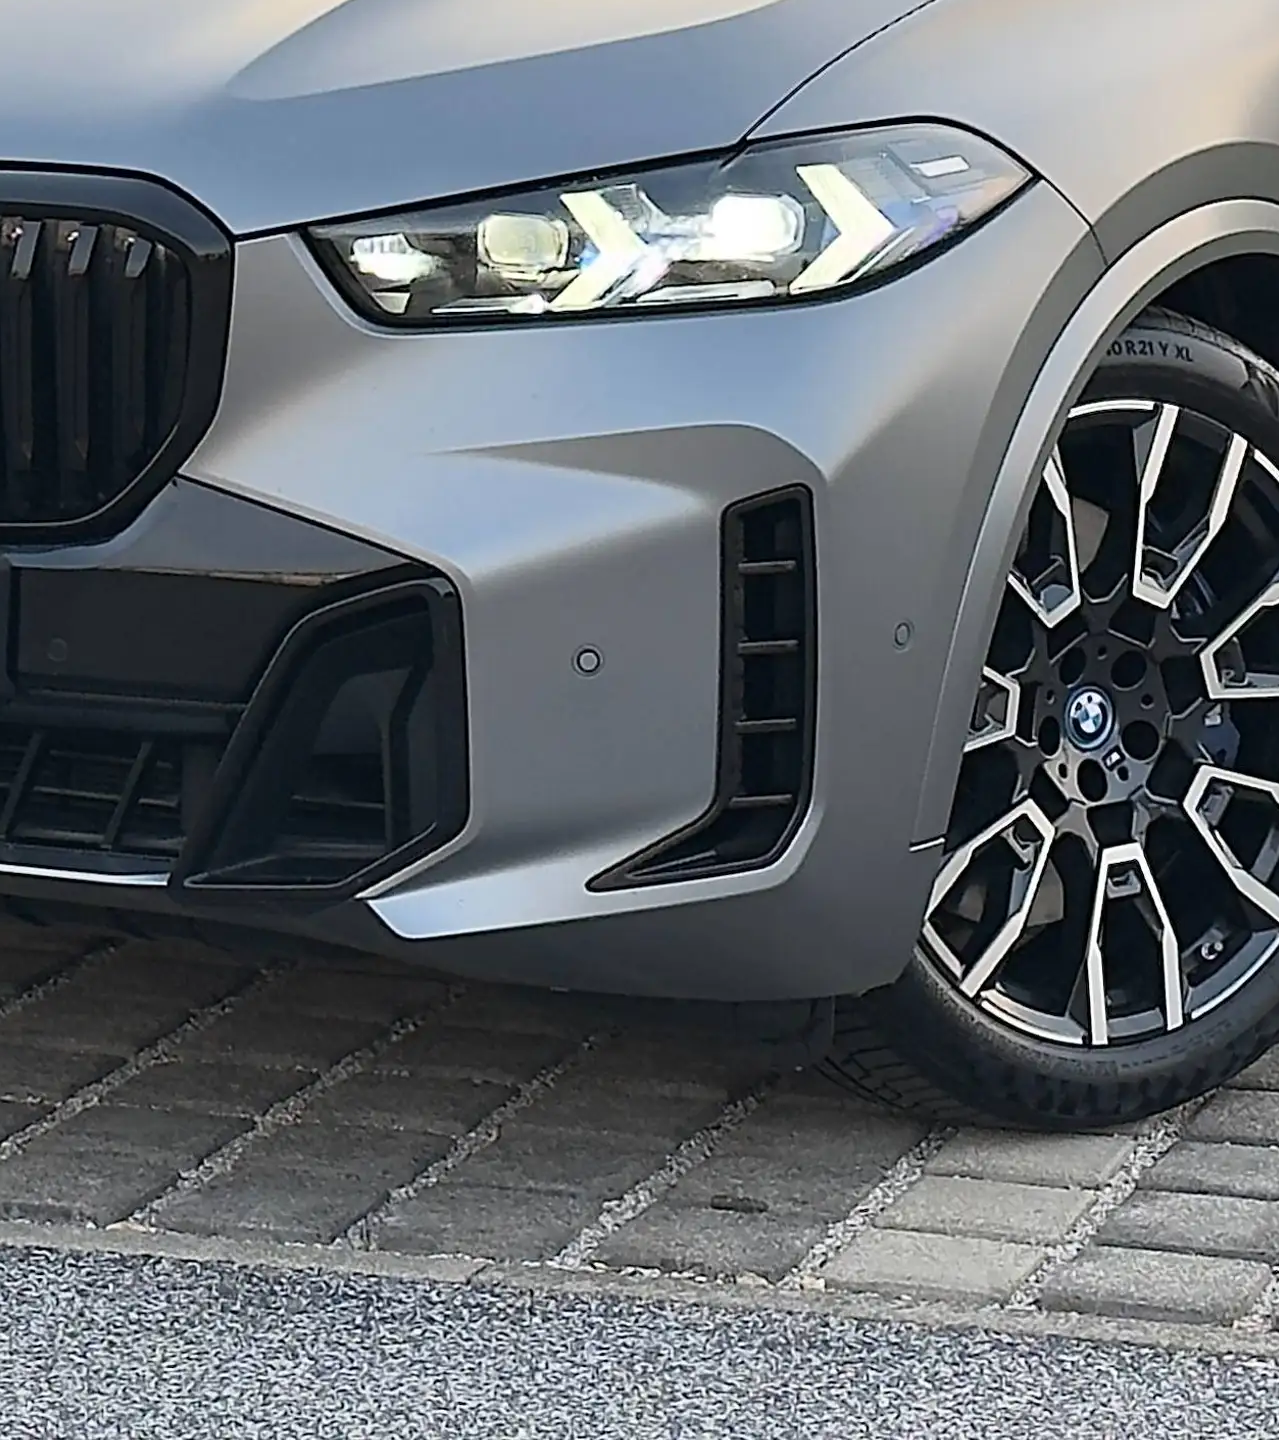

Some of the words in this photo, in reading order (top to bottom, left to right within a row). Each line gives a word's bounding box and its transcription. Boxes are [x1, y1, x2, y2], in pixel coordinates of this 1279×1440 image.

[1106, 340, 1122, 357] 0
[1125, 339, 1154, 357] R21
[1174, 343, 1194, 363] XL
